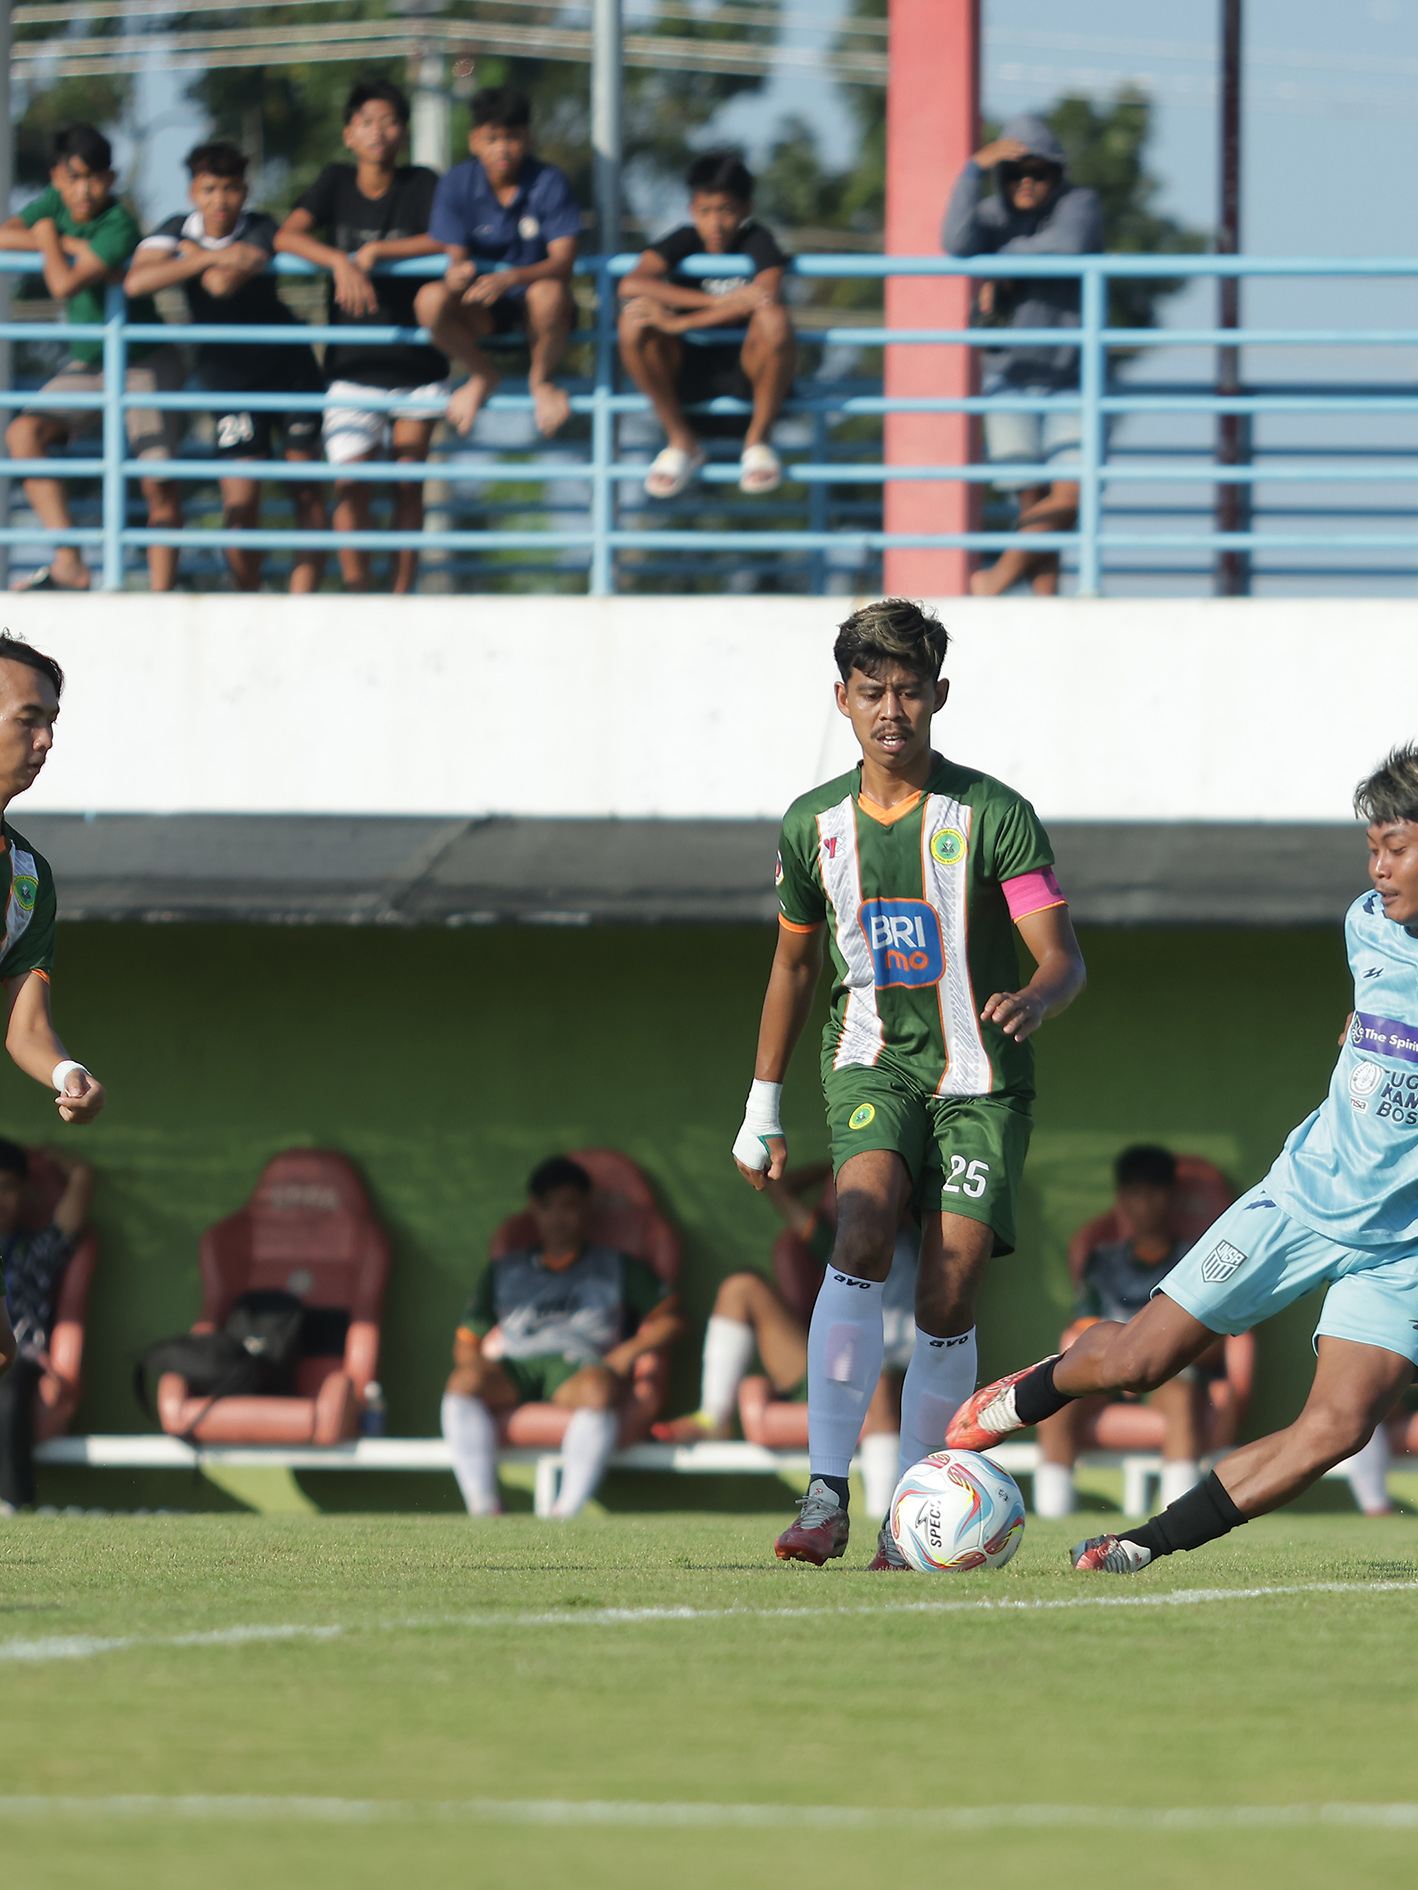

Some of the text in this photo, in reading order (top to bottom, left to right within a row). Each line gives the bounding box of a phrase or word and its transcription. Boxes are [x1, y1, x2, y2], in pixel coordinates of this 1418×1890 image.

[871, 915, 926, 949] BRI
[1365, 1028, 1387, 1043] The
[942, 1154, 990, 1198] 25
[1216, 1241, 1245, 1265] UNSA
